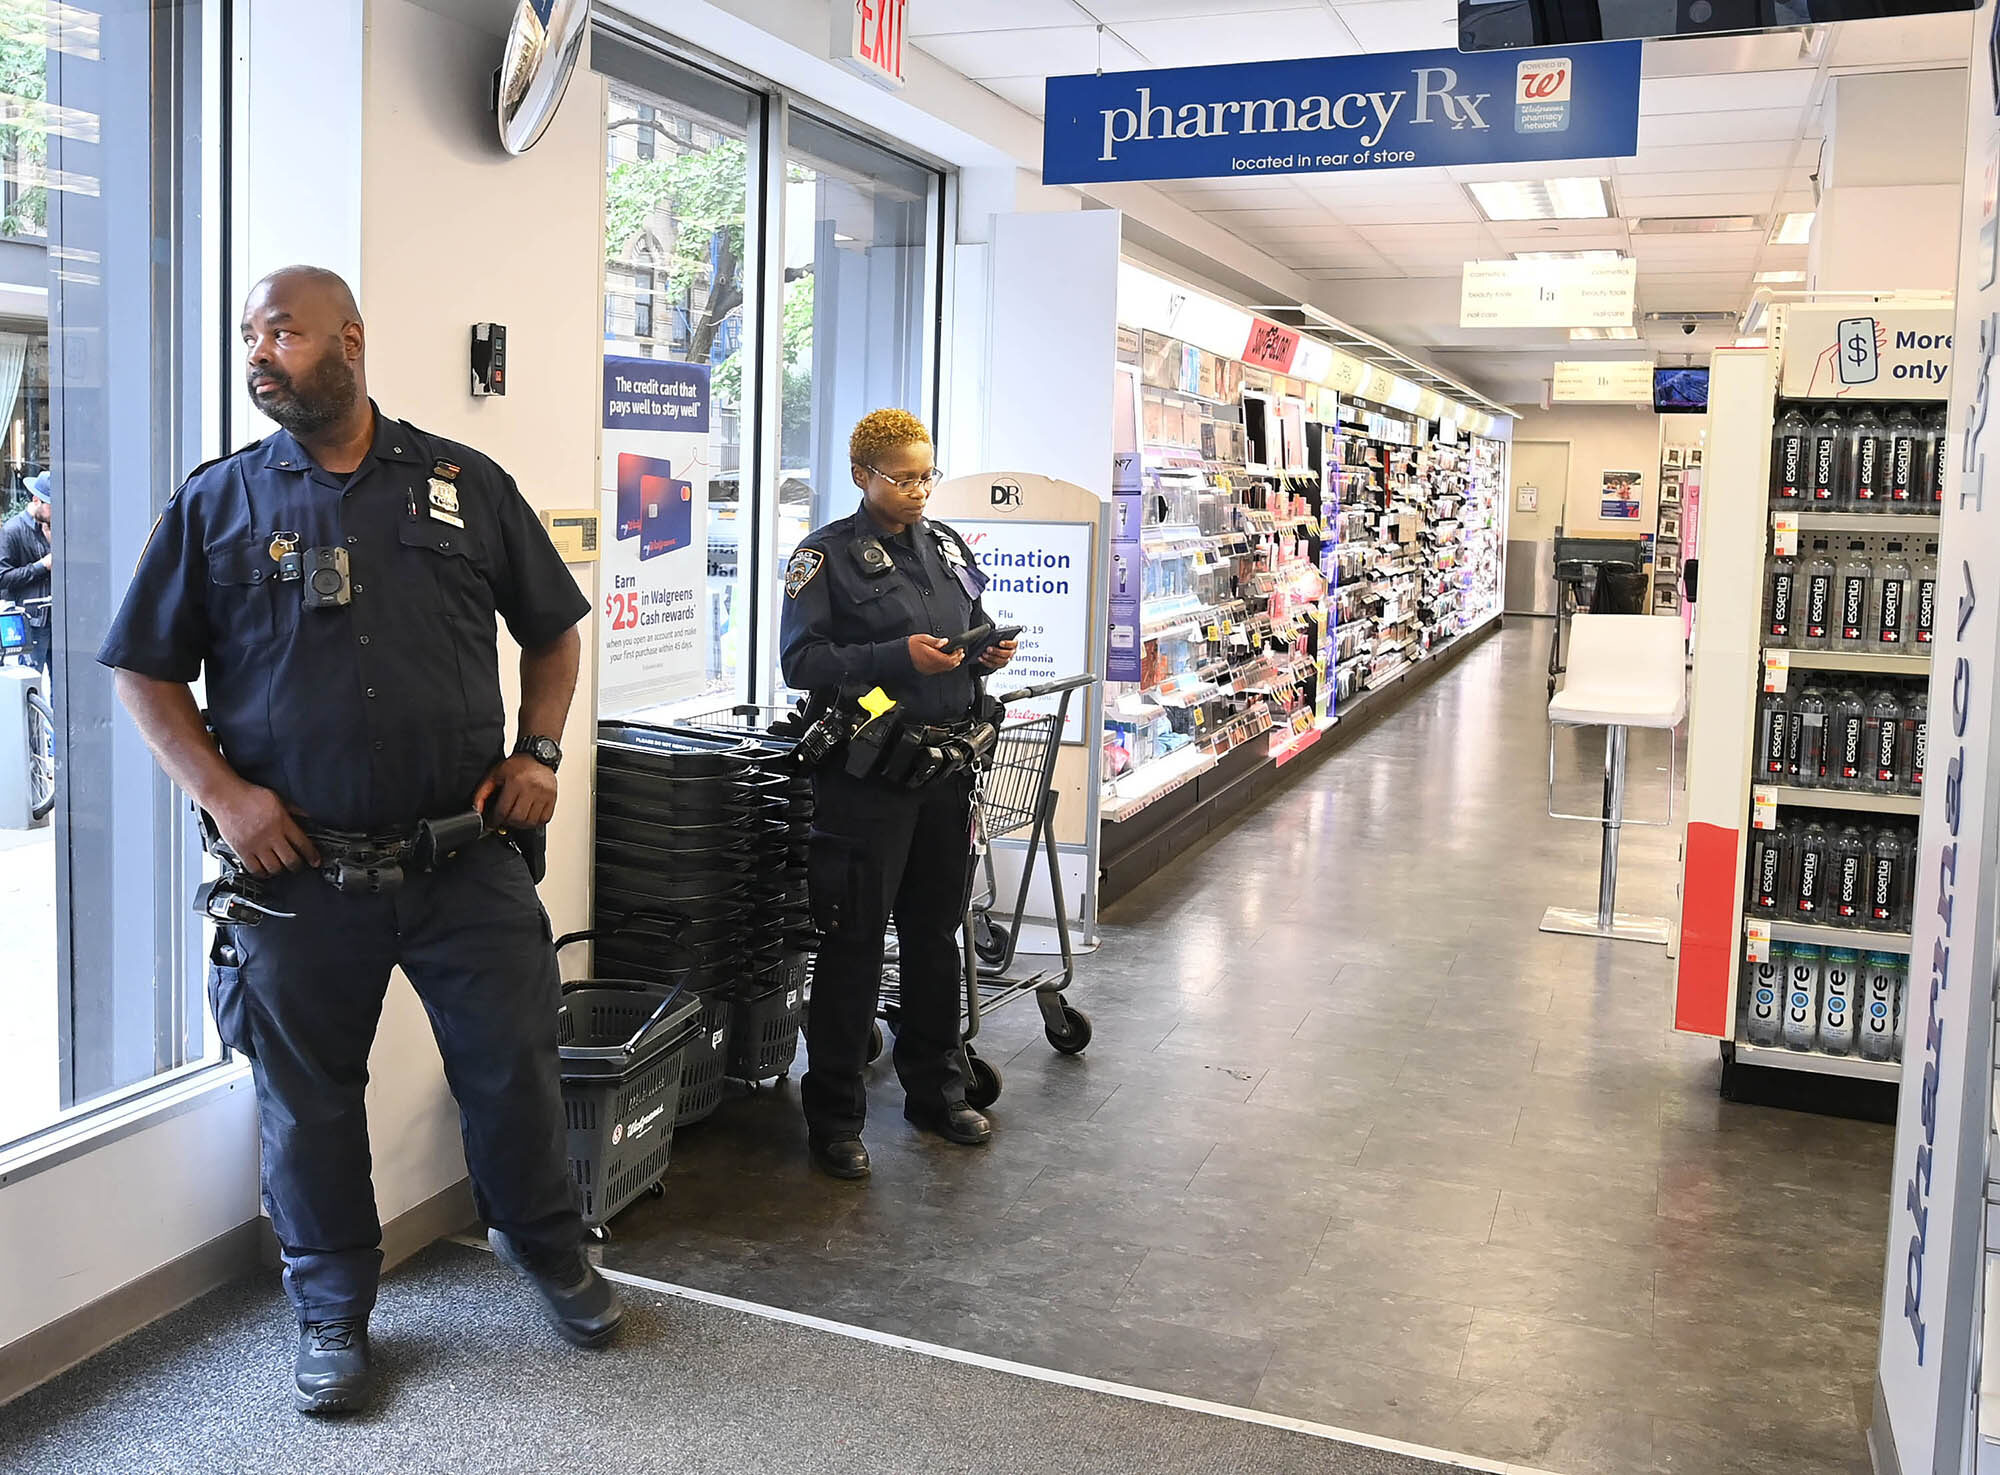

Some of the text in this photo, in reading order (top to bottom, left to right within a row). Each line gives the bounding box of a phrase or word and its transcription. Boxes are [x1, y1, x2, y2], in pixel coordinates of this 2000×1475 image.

[860, 0, 905, 78] EXIT
[1098, 67, 1491, 161] pharmacy Rx
[1521, 112, 1563, 124] pharmacy
[1524, 120, 1558, 130] network
[1232, 150, 1416, 171] located in rear of store
[1896, 331, 1952, 349] More
[615, 376, 697, 398] The credit card that
[1892, 359, 1948, 384] only
[609, 400, 631, 417] pays
[632, 399, 651, 415] well
[651, 401, 662, 416] to
[662, 402, 680, 420] stay
[1785, 438, 1798, 482] essentia
[1818, 439, 1831, 484] essentia
[1861, 439, 1874, 484] essentia
[1897, 439, 1909, 485] essentia
[615, 575, 636, 589] Earn
[641, 588, 693, 606] in Walgreens
[1775, 576, 1788, 620] essentia
[1812, 578, 1825, 622] essentia
[1847, 579, 1860, 624] essentia
[606, 592, 639, 631] $25
[640, 610, 660, 626] Cash
[998, 609, 1014, 619] Flu
[1885, 582, 1897, 627] essentia
[1920, 582, 1933, 627] essentia
[606, 638, 621, 649] when
[622, 638, 633, 648] you
[633, 637, 646, 645] open
[647, 633, 654, 642] an
[654, 630, 673, 641] account
[674, 629, 684, 637] and
[610, 654, 622, 664] your
[623, 649, 634, 660] first
[635, 647, 658, 660] purchase
[659, 643, 673, 653] within
[1008, 668, 1027, 676] and
[1029, 669, 1056, 677] more
[635, 737, 654, 745] PLEASE
[1772, 714, 1784, 758] essentia
[1846, 719, 1858, 763] essentia
[1881, 721, 1893, 766] essentia
[1915, 723, 1927, 768] essentia
[1763, 849, 1775, 893] essentia
[1802, 853, 1816, 897] essentia
[1842, 858, 1855, 902] essentia
[1877, 860, 1889, 904] essentia
[1756, 963, 1775, 1019] core
[1791, 965, 1810, 1023] core
[1827, 969, 1846, 1028] core
[1870, 975, 1888, 1033] core
